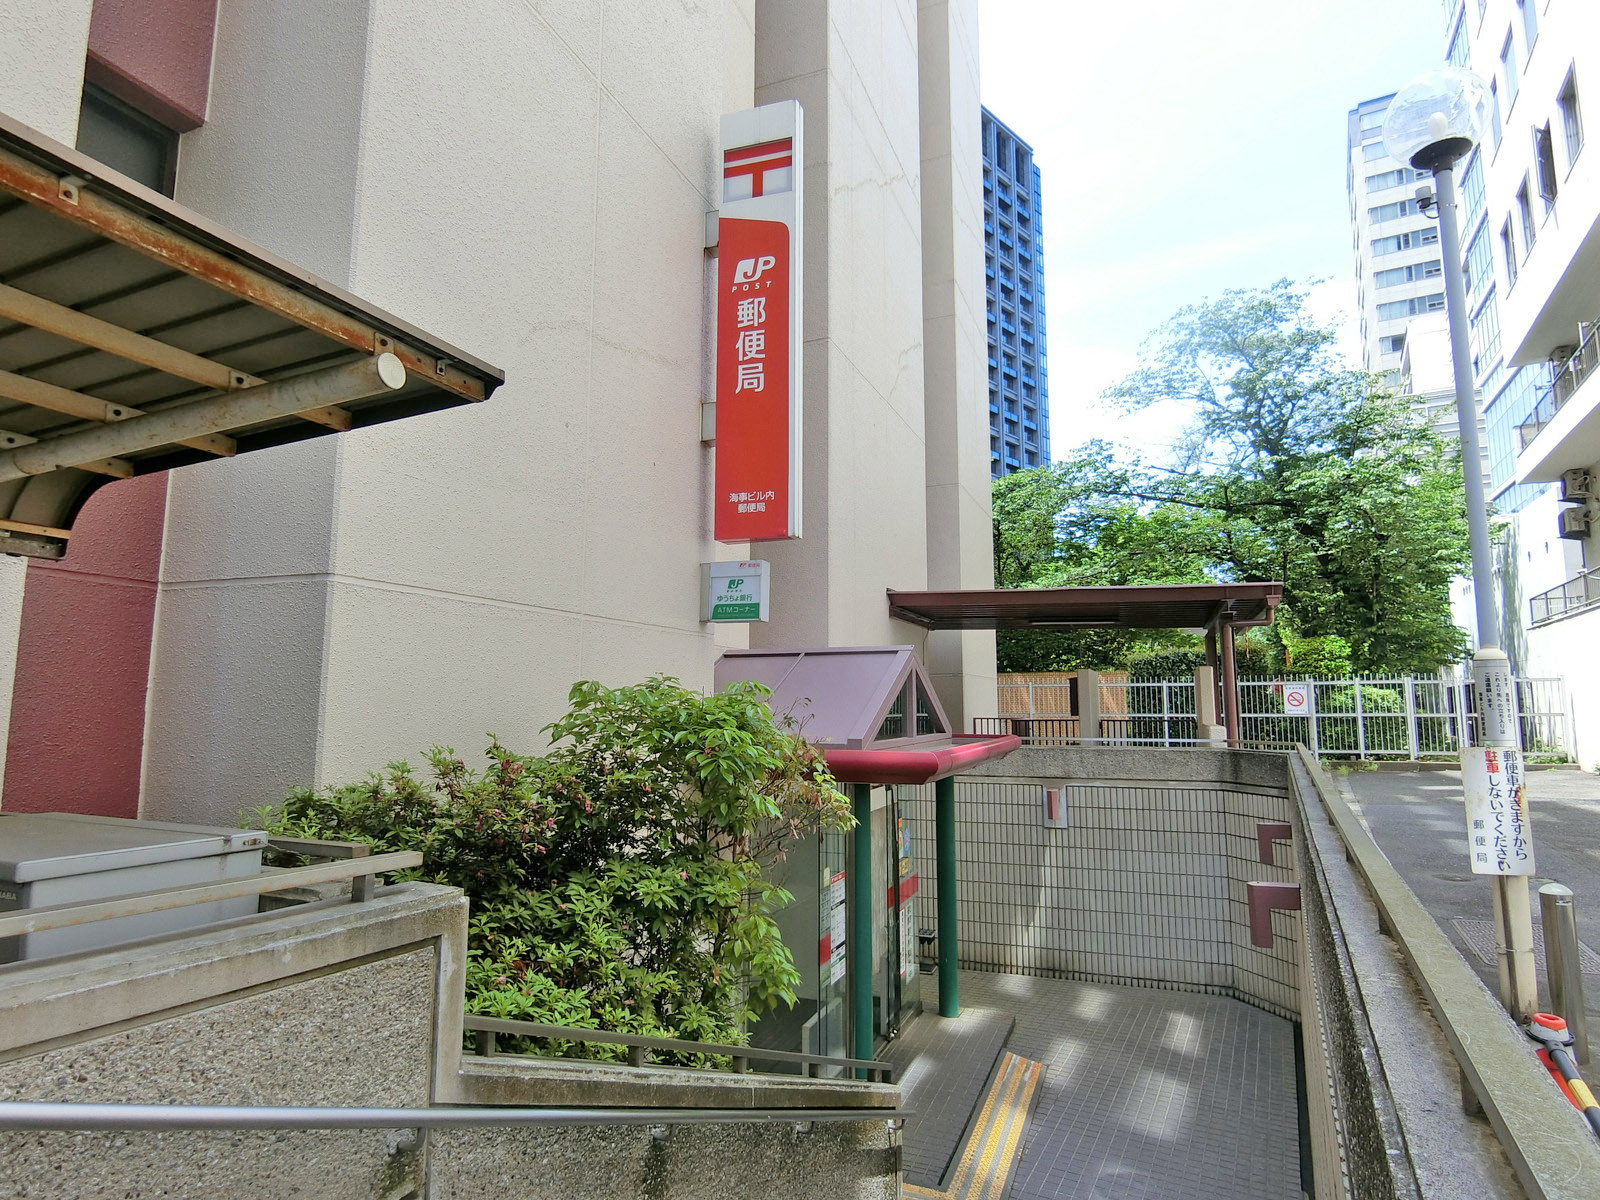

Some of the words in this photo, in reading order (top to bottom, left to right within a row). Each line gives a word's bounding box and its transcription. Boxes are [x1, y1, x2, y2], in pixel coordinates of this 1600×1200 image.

[734, 256, 776, 283] JP
[732, 281, 772, 293] POST
[735, 297, 766, 394] 郵便局
[729, 491, 775, 502] 海事ビル内
[738, 503, 766, 513] 郵便局
[728, 579, 744, 589] JP
[716, 594, 752, 602] ゆうちょ銀行
[1484, 750, 1511, 872] 駐車しないでください
[1473, 819, 1488, 863] 郵便局
